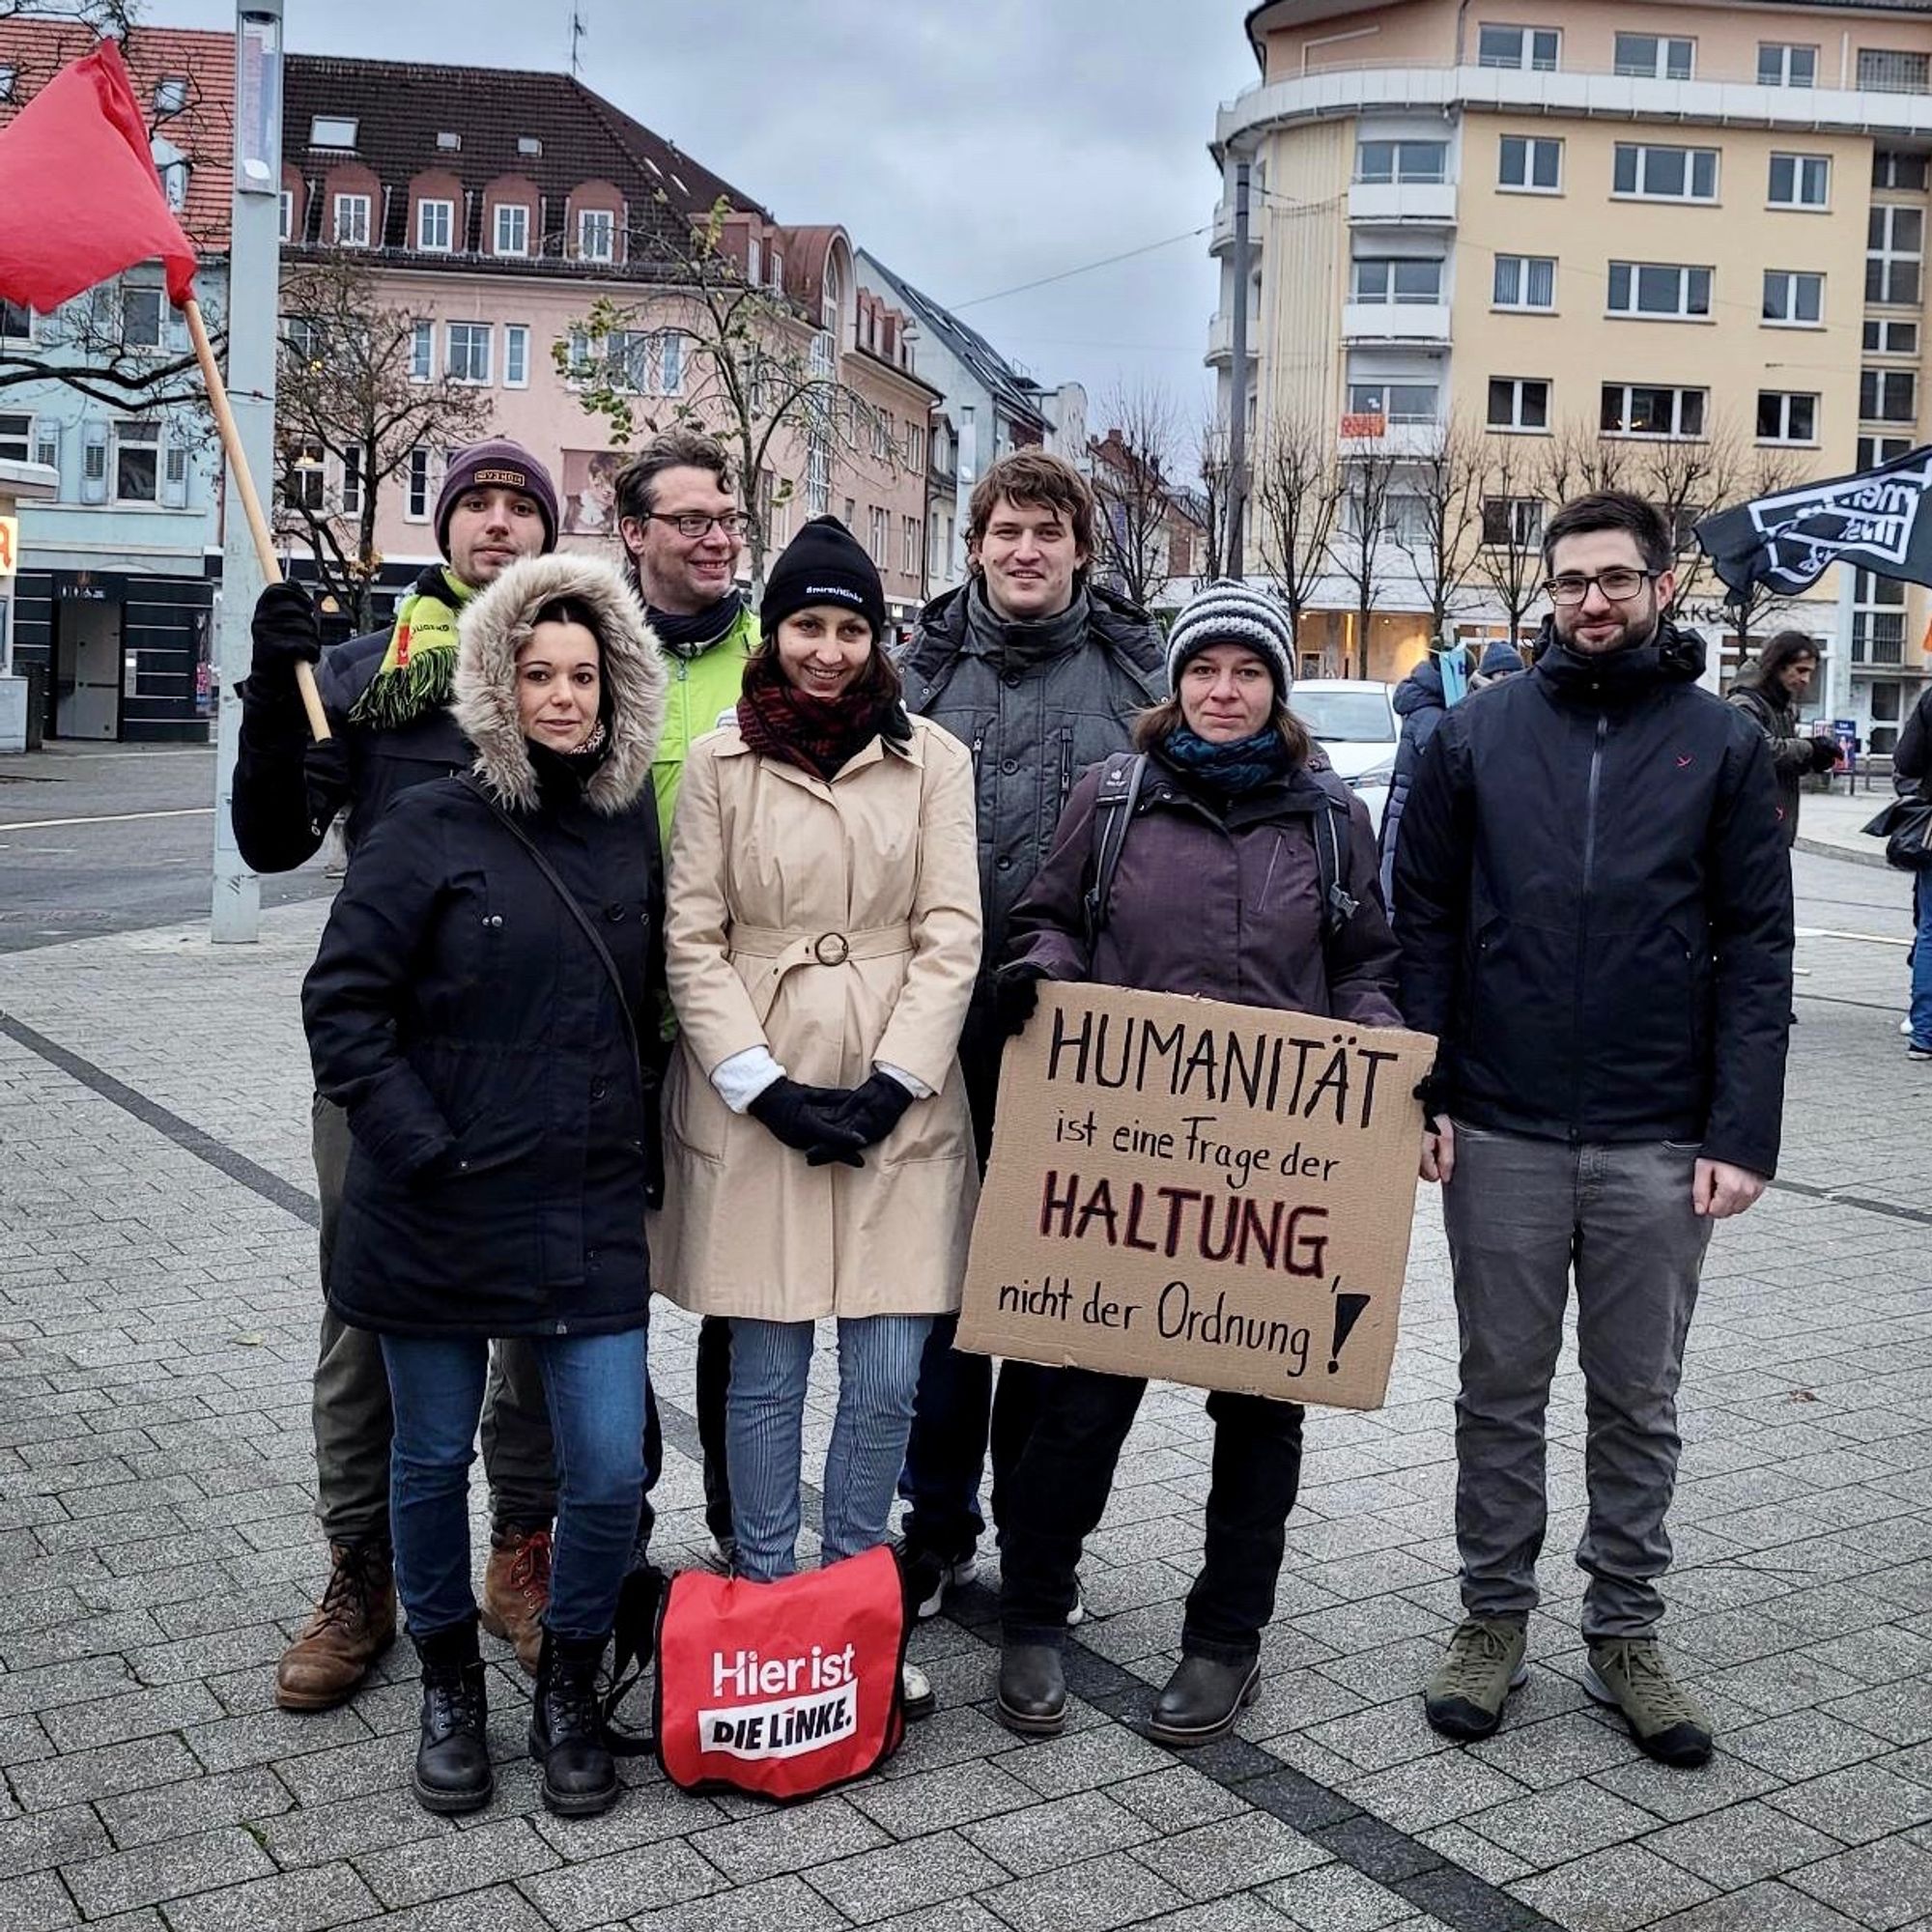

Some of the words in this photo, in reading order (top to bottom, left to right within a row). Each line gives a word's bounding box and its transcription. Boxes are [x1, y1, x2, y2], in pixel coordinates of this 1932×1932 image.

[1048, 1008, 1398, 1128] HUMANITÄT
[1057, 1111, 1097, 1147] ist
[1113, 1121, 1174, 1159] eine
[1182, 1117, 1270, 1188] Frage
[1280, 1142, 1339, 1181] der
[999, 1277, 1072, 1316] nicht
[1082, 1282, 1142, 1330] der
[713, 1650, 806, 1696] Hier
[810, 1643, 855, 1690] ist
[712, 1717, 763, 1749] DIE
